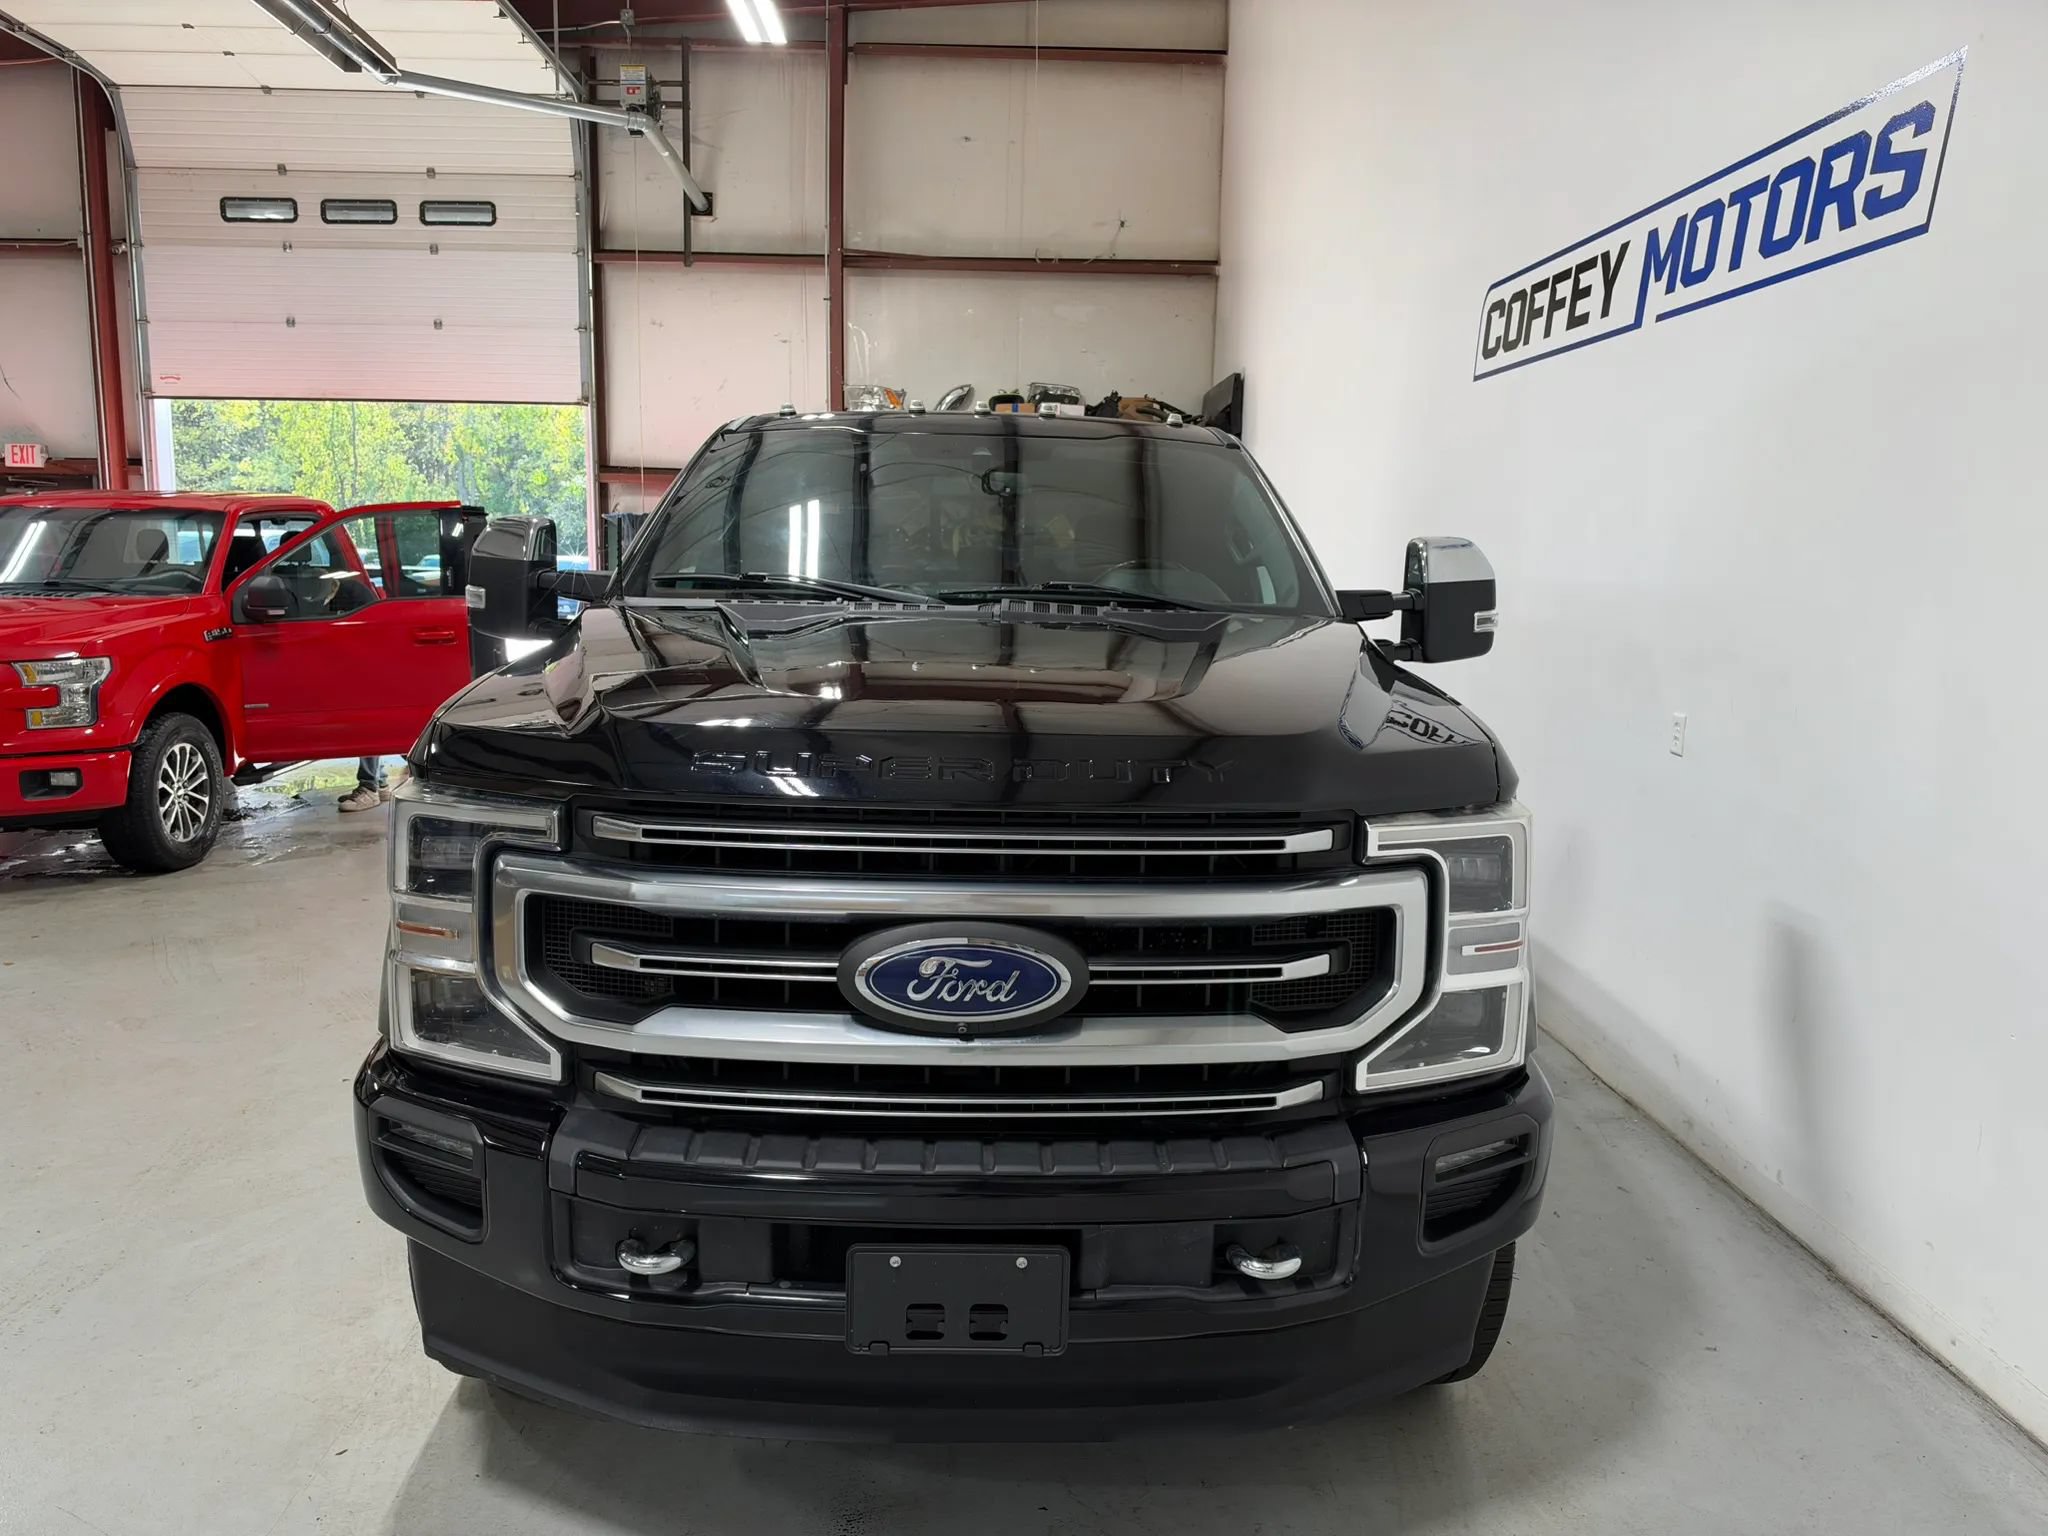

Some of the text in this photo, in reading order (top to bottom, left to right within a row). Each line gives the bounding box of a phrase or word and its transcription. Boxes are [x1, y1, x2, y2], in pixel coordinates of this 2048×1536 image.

[1481, 100, 1937, 361] COFFEY MOTORS
[11, 444, 36, 465] EXIT
[690, 749, 1236, 784] SUPER DUTY
[906, 955, 1021, 1003] Ford
